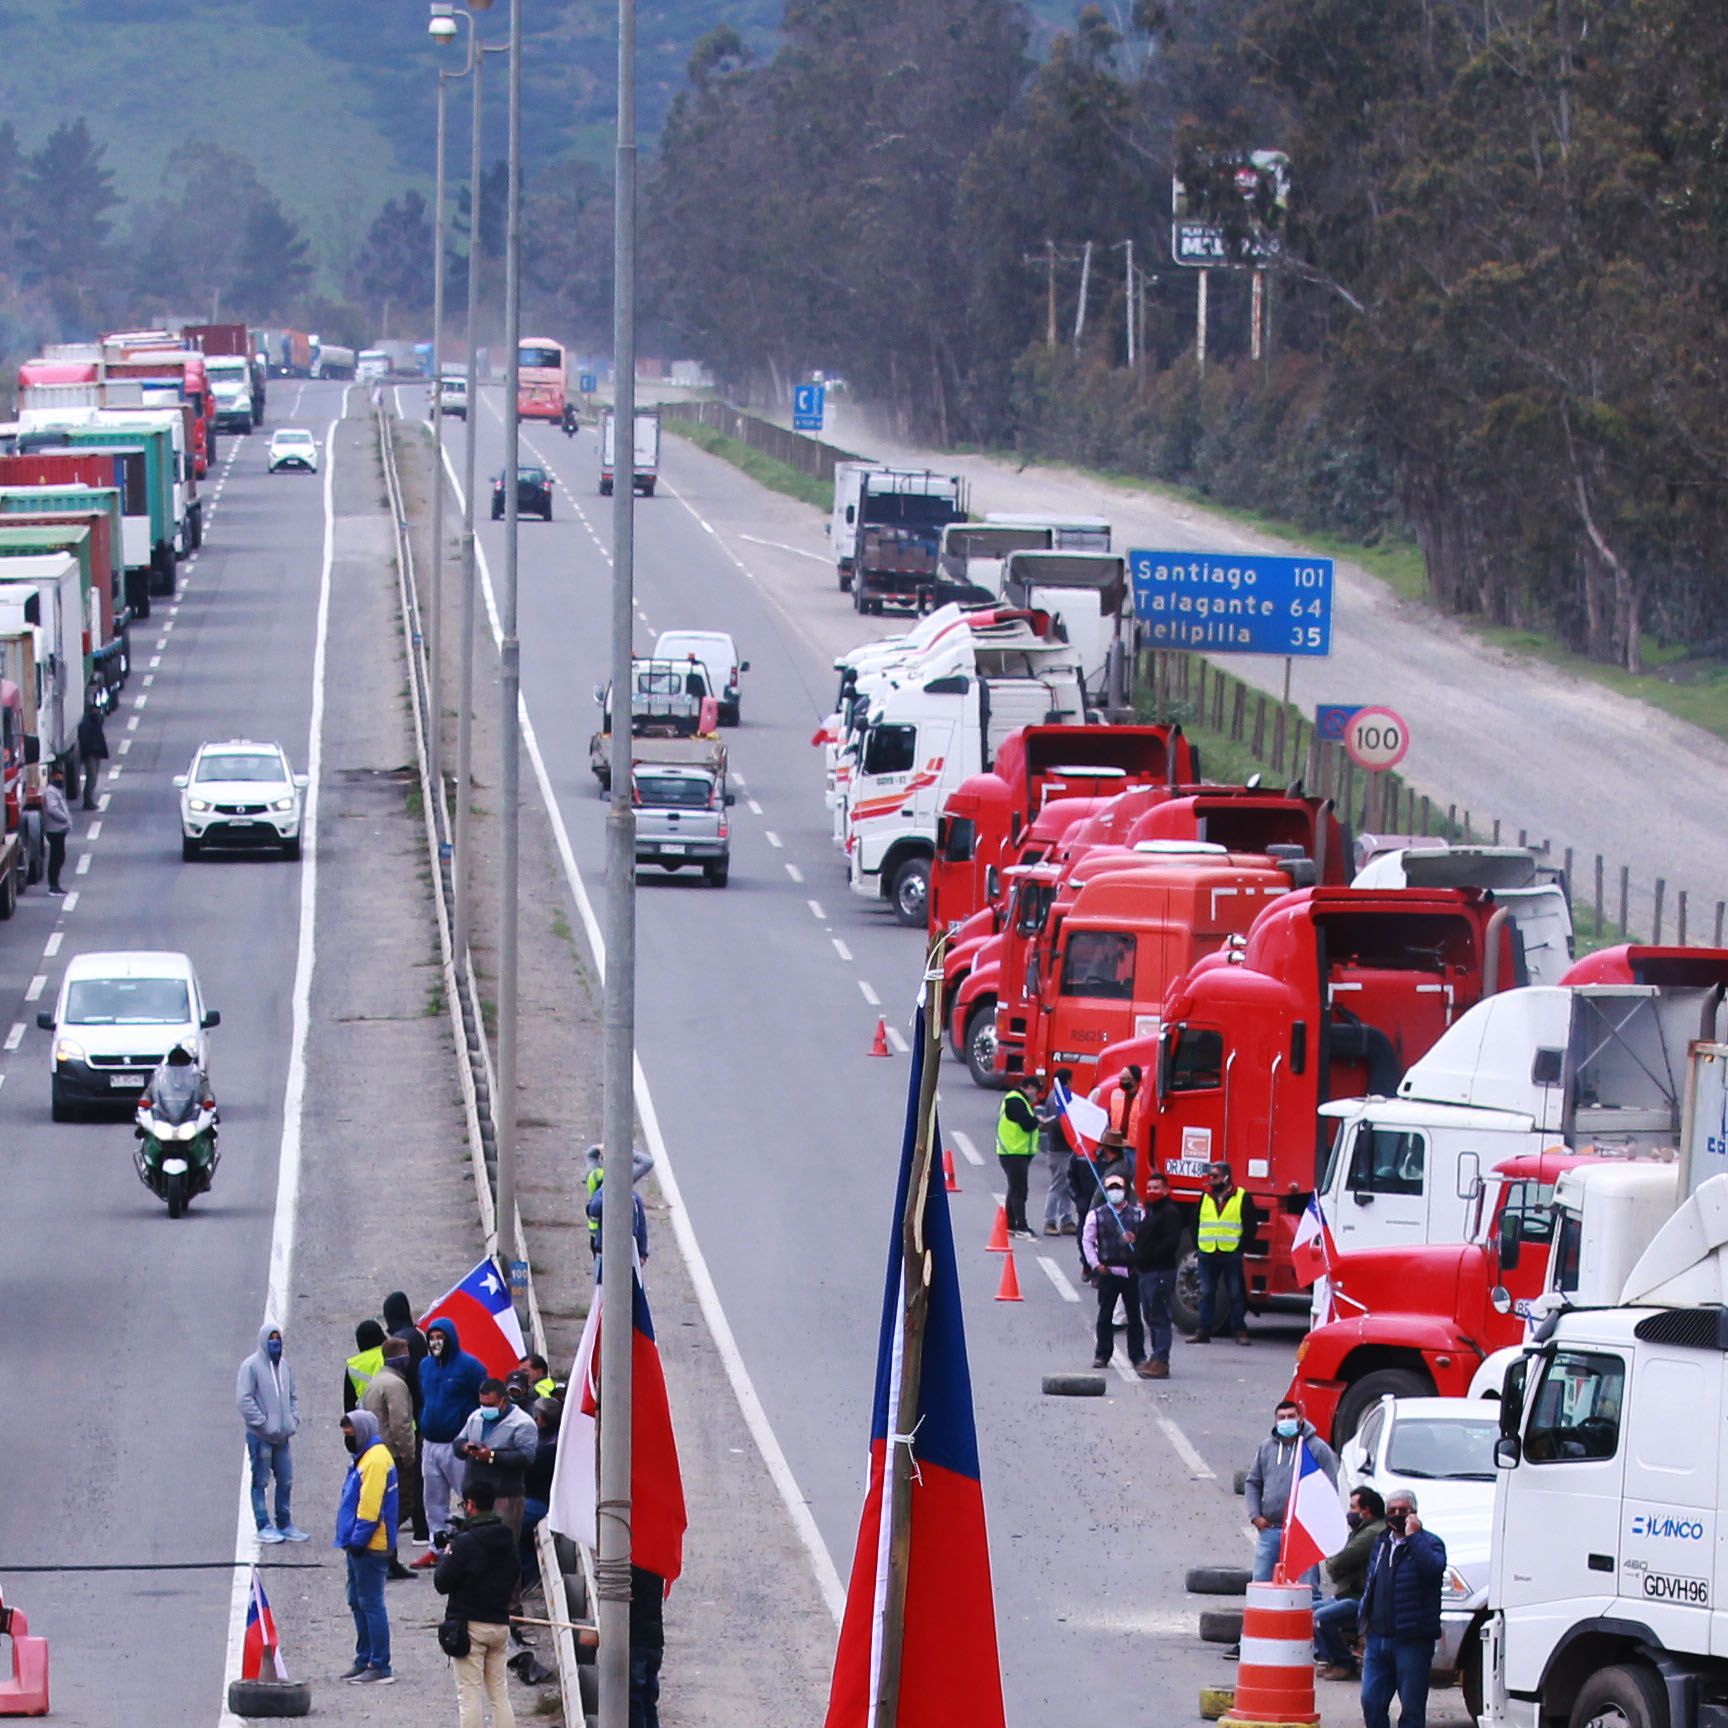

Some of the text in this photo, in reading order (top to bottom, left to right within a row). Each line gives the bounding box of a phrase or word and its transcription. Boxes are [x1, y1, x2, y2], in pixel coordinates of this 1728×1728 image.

[1137, 560, 1325, 590] Santiago 101
[1137, 589, 1321, 618] Talagante 64
[1139, 619, 1321, 648] Melipilla 35
[1357, 726, 1399, 750] 100
